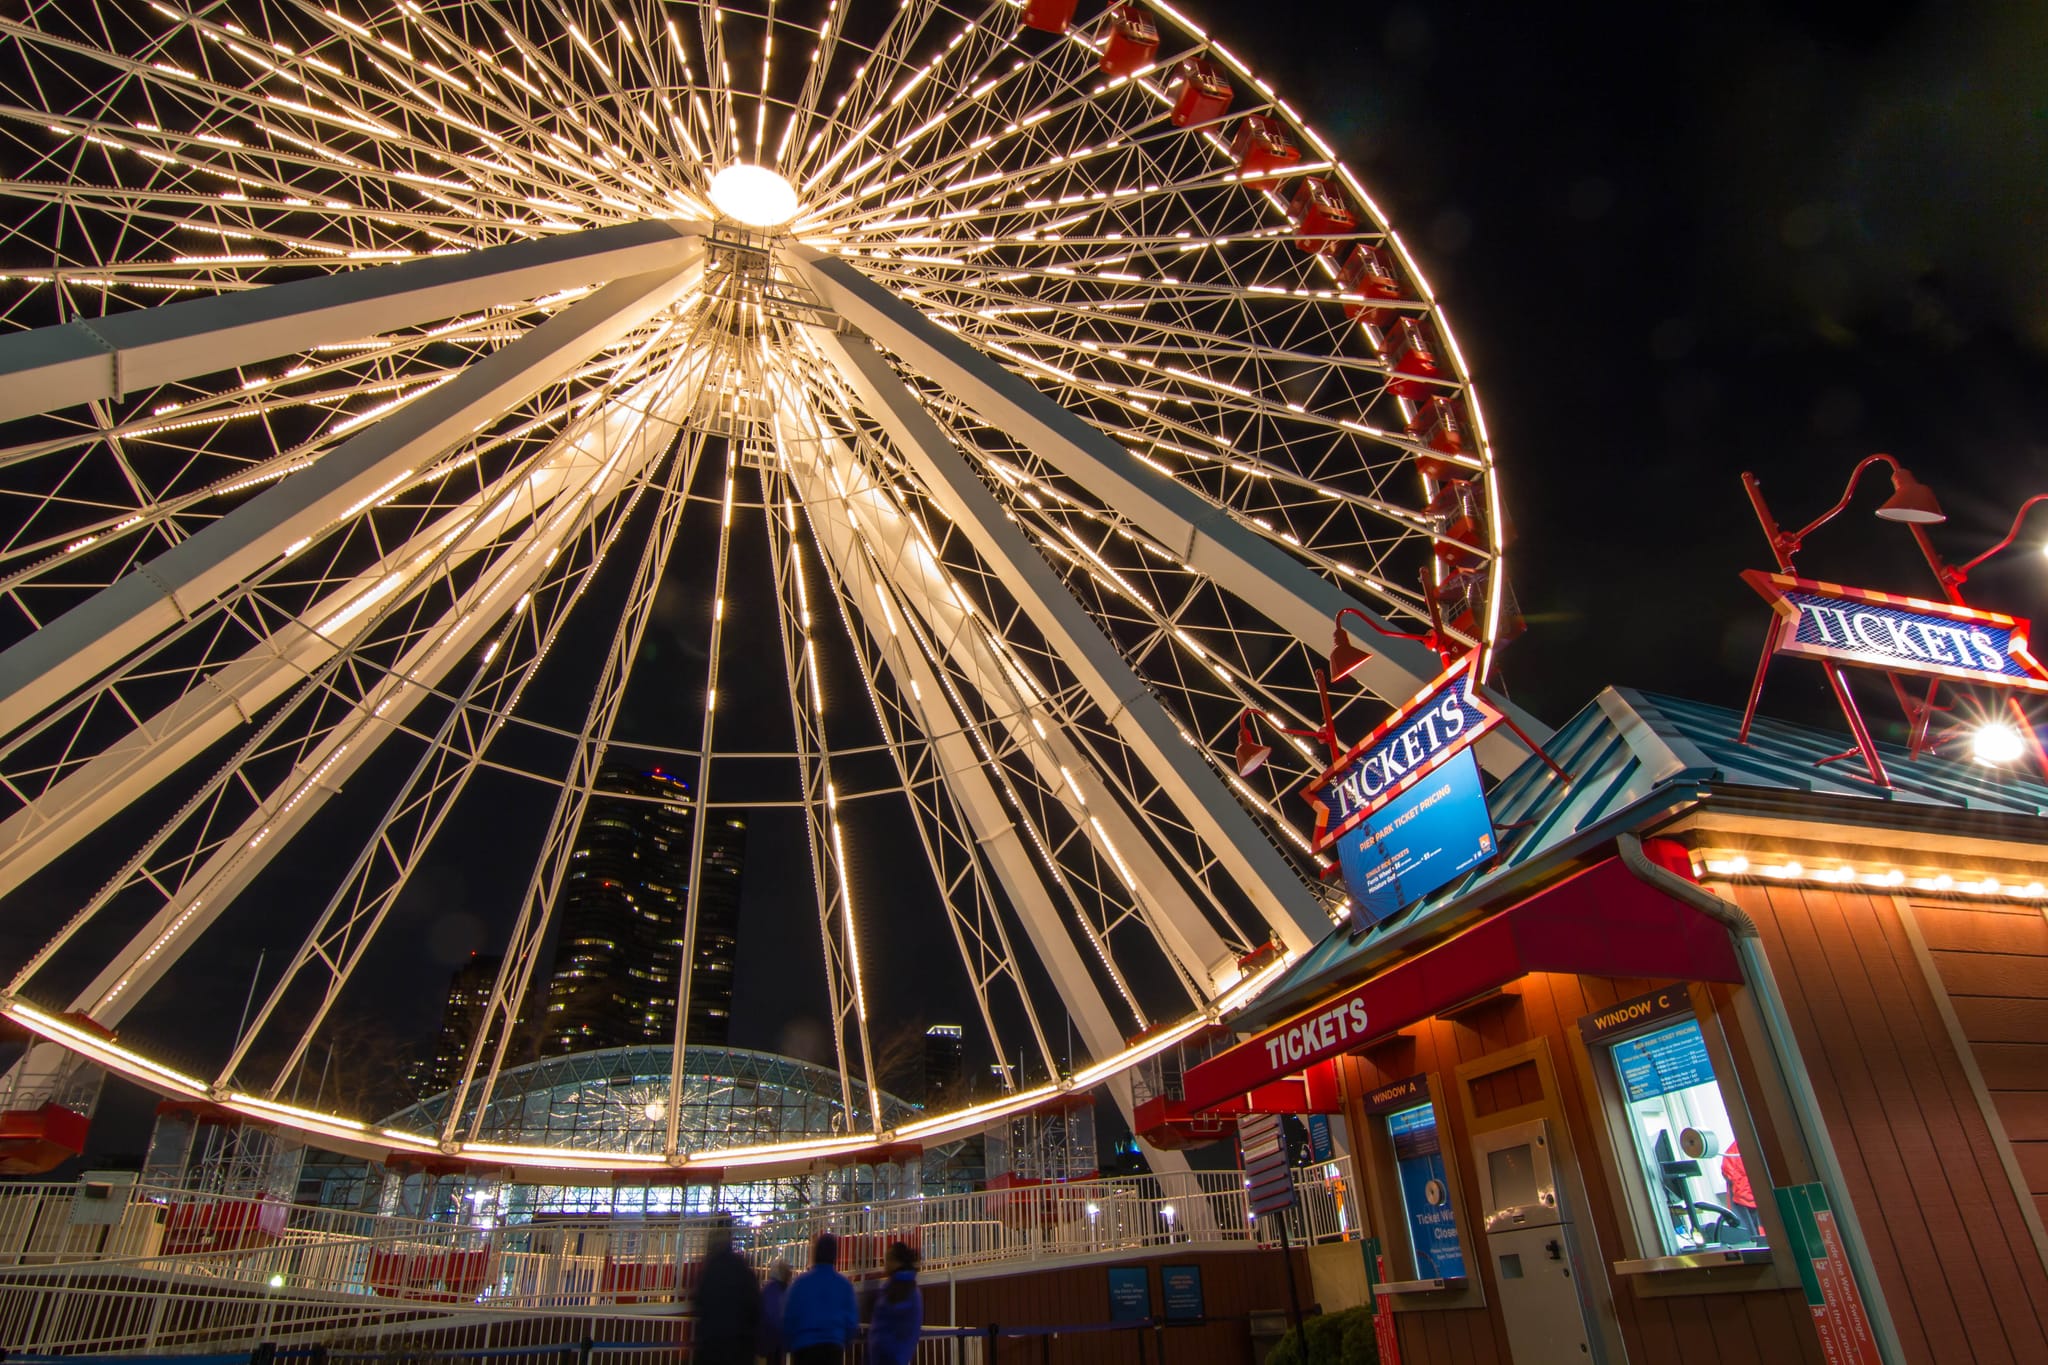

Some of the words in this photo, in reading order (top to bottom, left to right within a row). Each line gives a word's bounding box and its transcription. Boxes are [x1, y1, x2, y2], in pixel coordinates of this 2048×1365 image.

[1798, 603, 2004, 670] TICKETS
[1332, 694, 1464, 818] TICKETS
[1360, 836, 1375, 852] PIER
[1375, 823, 1394, 841] PARK
[1394, 805, 1419, 828] TICKET
[1419, 784, 1451, 811] PRICING
[1265, 997, 1368, 1070] TICKETS
[1594, 1001, 1651, 1030] WINDOW
[1658, 995, 1670, 1008] C
[1372, 1084, 1406, 1104] WINDOW
[1409, 1082, 1416, 1093] A
[1416, 1212, 1440, 1224] Ticket
[1434, 1227, 1458, 1239] Close
[1823, 1278, 1830, 1288] to
[1827, 1289, 1837, 1307] ride
[1833, 1309, 1842, 1325] the
[1828, 1241, 1839, 1258] ride
[1835, 1260, 1845, 1275] the
[1841, 1276, 1853, 1302] Wave
[1849, 1303, 1867, 1342] Swinger
[1820, 1325, 1828, 1335] to
[1824, 1337, 1834, 1355] ride
